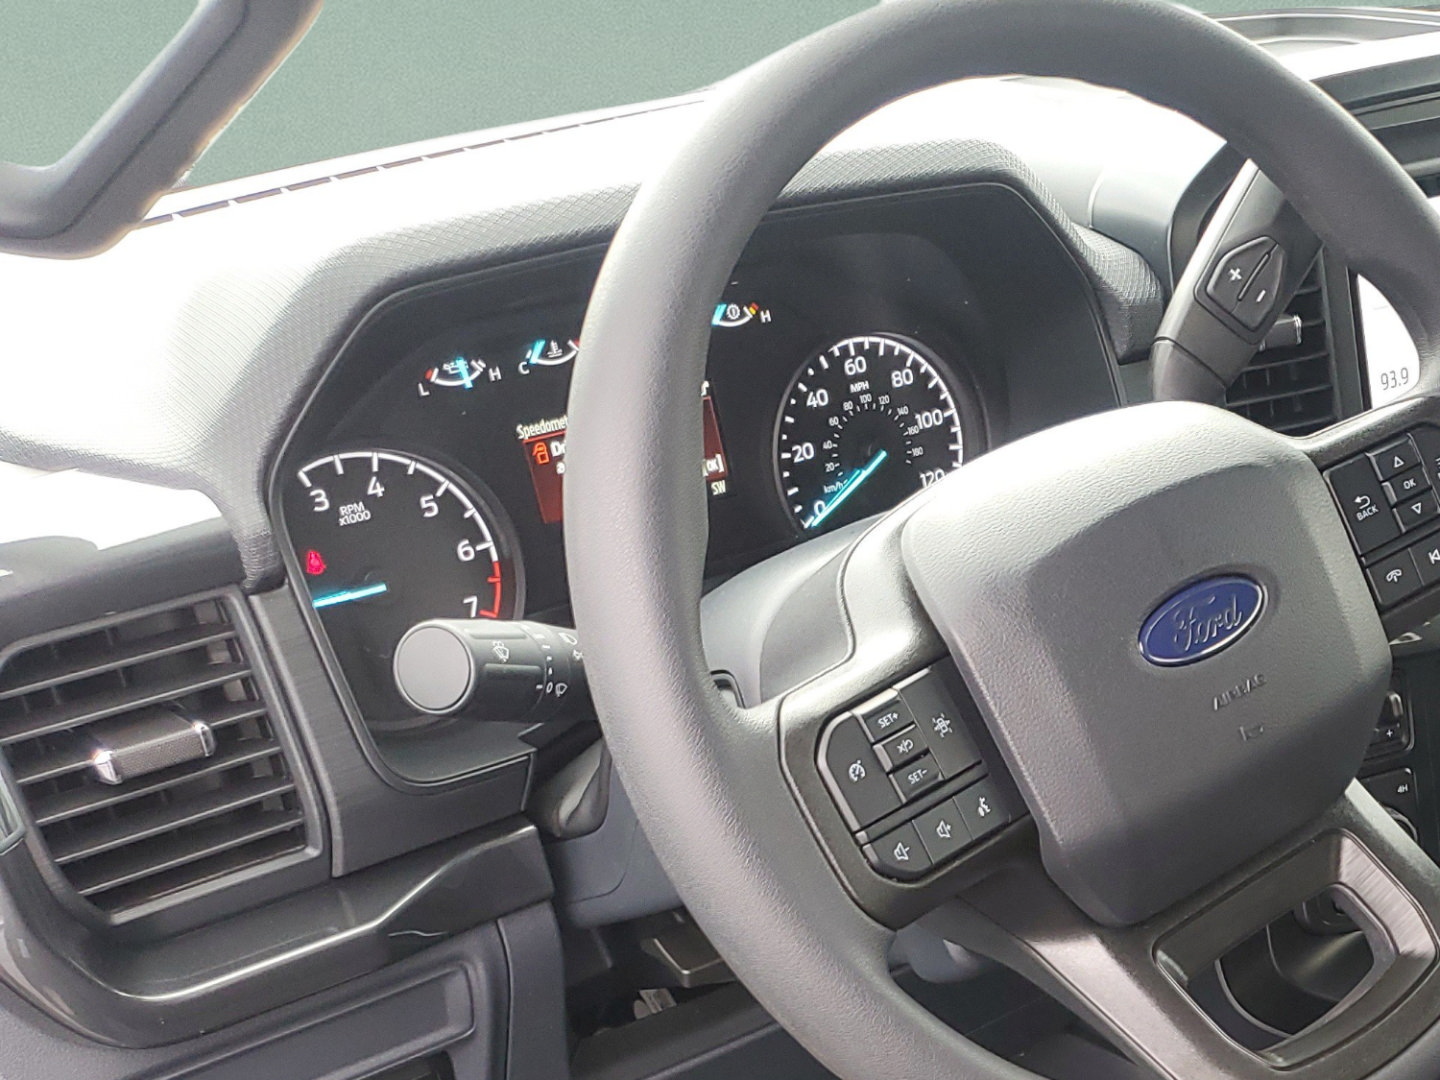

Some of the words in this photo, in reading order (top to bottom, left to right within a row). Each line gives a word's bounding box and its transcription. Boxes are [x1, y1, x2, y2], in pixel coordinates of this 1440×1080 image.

[760, 309, 772, 324] H
[488, 366, 502, 382] H
[518, 361, 530, 375] C
[844, 356, 867, 376] 60
[850, 380, 870, 393] MPH
[891, 368, 914, 389] 80
[1380, 367, 1409, 391] 93.9
[418, 383, 430, 397] L
[806, 388, 829, 408] 40
[842, 401, 853, 412] 80
[859, 393, 872, 404] 100
[878, 394, 890, 405] 120
[897, 405, 909, 416] 140
[828, 416, 839, 427] 60
[915, 408, 944, 430] 100
[791, 442, 815, 464] 20
[822, 440, 833, 450] 40
[825, 462, 835, 473] 20
[367, 476, 385, 497] 4
[823, 480, 844, 494] km/h
[1403, 478, 1417, 490] OK
[309, 489, 330, 512] 3
[339, 501, 365, 516] RPM
[420, 494, 439, 518] 5
[813, 500, 826, 516] 0
[339, 510, 371, 527] x1000
[1356, 504, 1379, 522] BACK
[457, 539, 476, 562] 6
[463, 596, 478, 618] 7
[1174, 594, 1243, 652] Ford
[877, 712, 899, 729] SET+
